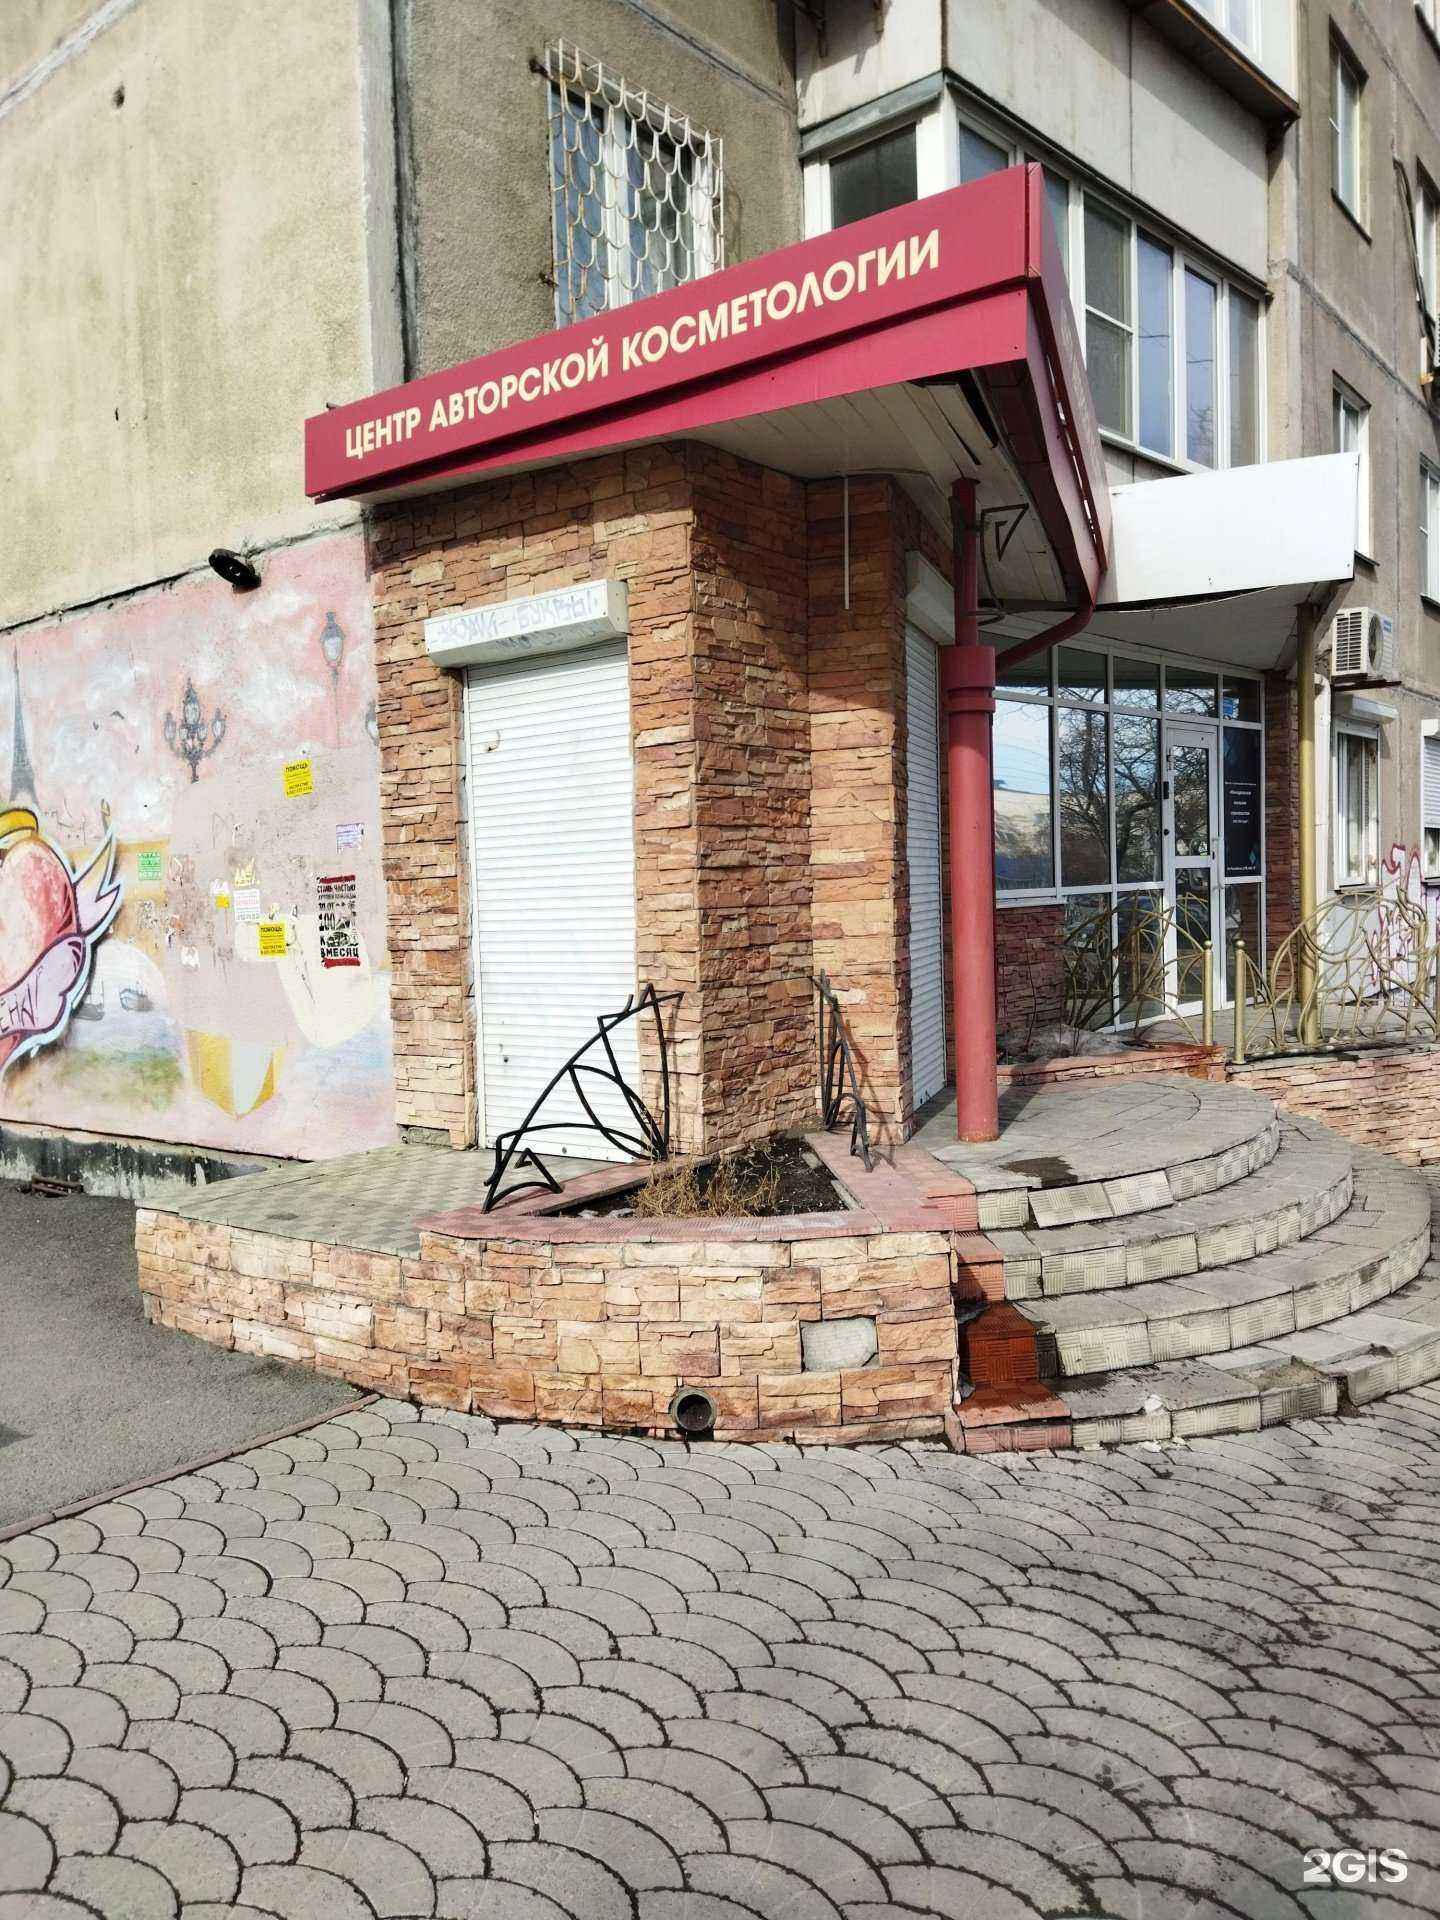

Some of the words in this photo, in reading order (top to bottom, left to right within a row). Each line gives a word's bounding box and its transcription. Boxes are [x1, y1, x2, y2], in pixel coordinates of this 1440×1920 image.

[345, 406, 422, 460] ЦЕНТР
[428, 335, 609, 433] АВТОРСКОЙ
[622, 228, 940, 372] КОСМЕТОЛОГИИ
[326, 947, 359, 958] МЕСЯЦ
